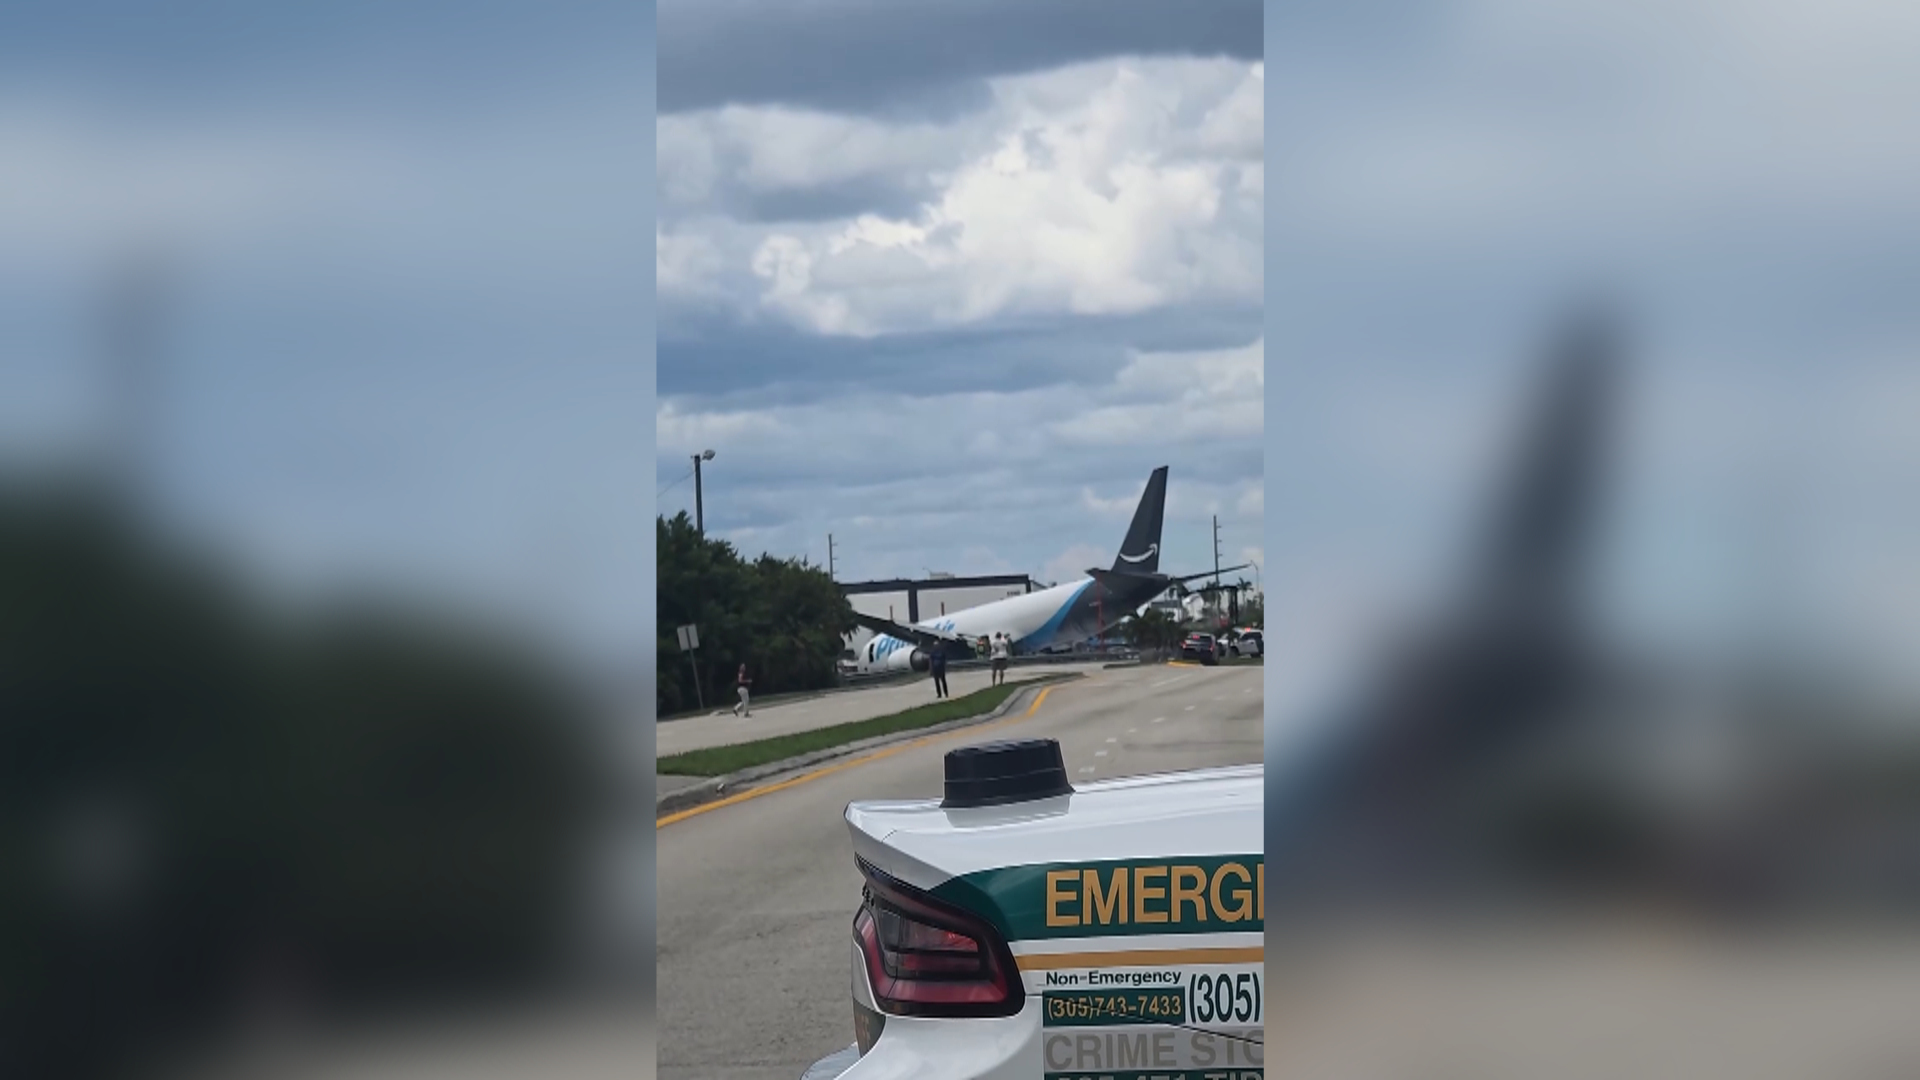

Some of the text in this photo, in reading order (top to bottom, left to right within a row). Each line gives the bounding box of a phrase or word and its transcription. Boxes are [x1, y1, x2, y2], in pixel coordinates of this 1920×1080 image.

[1046, 863, 1264, 927] EMERG
[1045, 970, 1182, 986] Non-Emergency
[1048, 995, 1181, 1020] (305)743-7433
[1189, 972, 1261, 1023] (305)
[1045, 1032, 1177, 1070] CRIME
